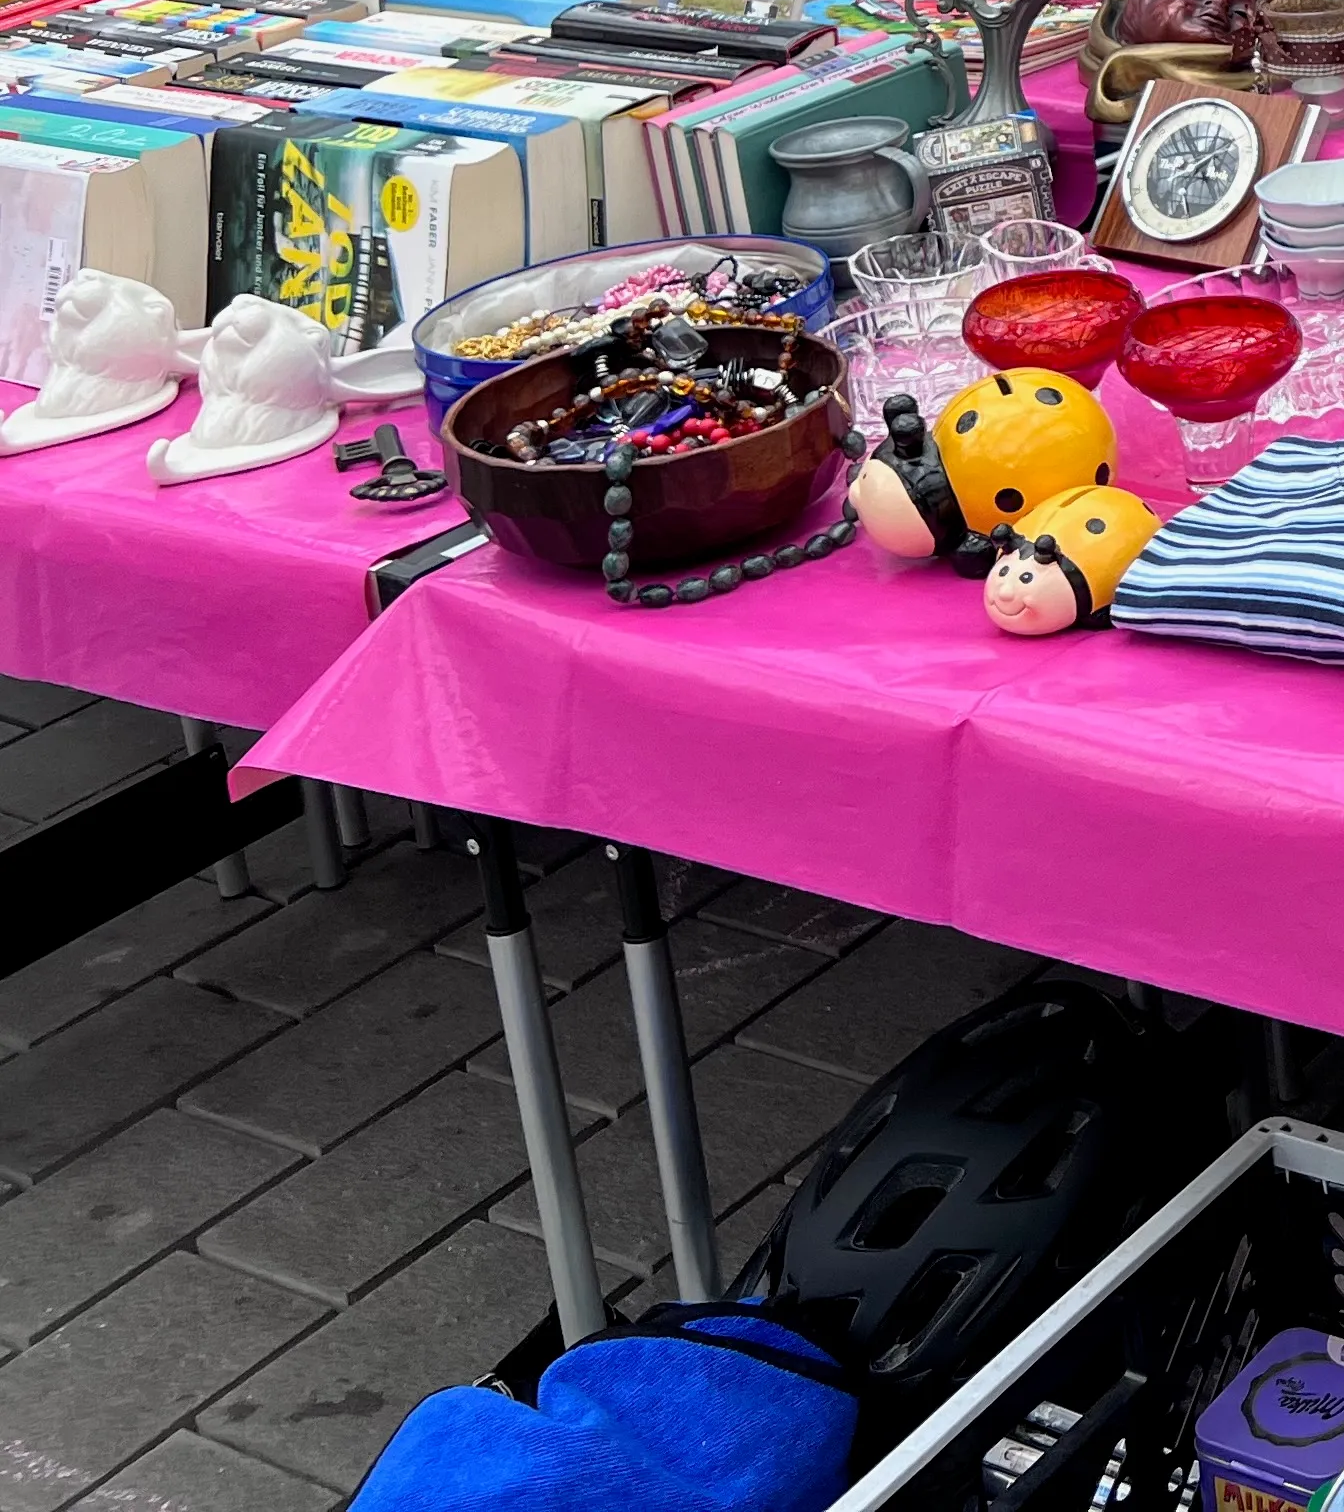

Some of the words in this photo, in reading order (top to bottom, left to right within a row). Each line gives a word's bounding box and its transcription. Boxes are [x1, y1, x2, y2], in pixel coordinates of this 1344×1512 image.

[344, 123, 399, 143] TOD
[256, 153, 268, 171] Ein
[257, 171, 267, 195] Fall
[941, 177, 969, 196] EXIT
[978, 170, 1023, 184] ESCAPE
[965, 179, 1004, 195] PUZZLE
[255, 211, 266, 246] Juncker
[428, 206, 439, 249] FABER
[255, 246, 265, 268] und
